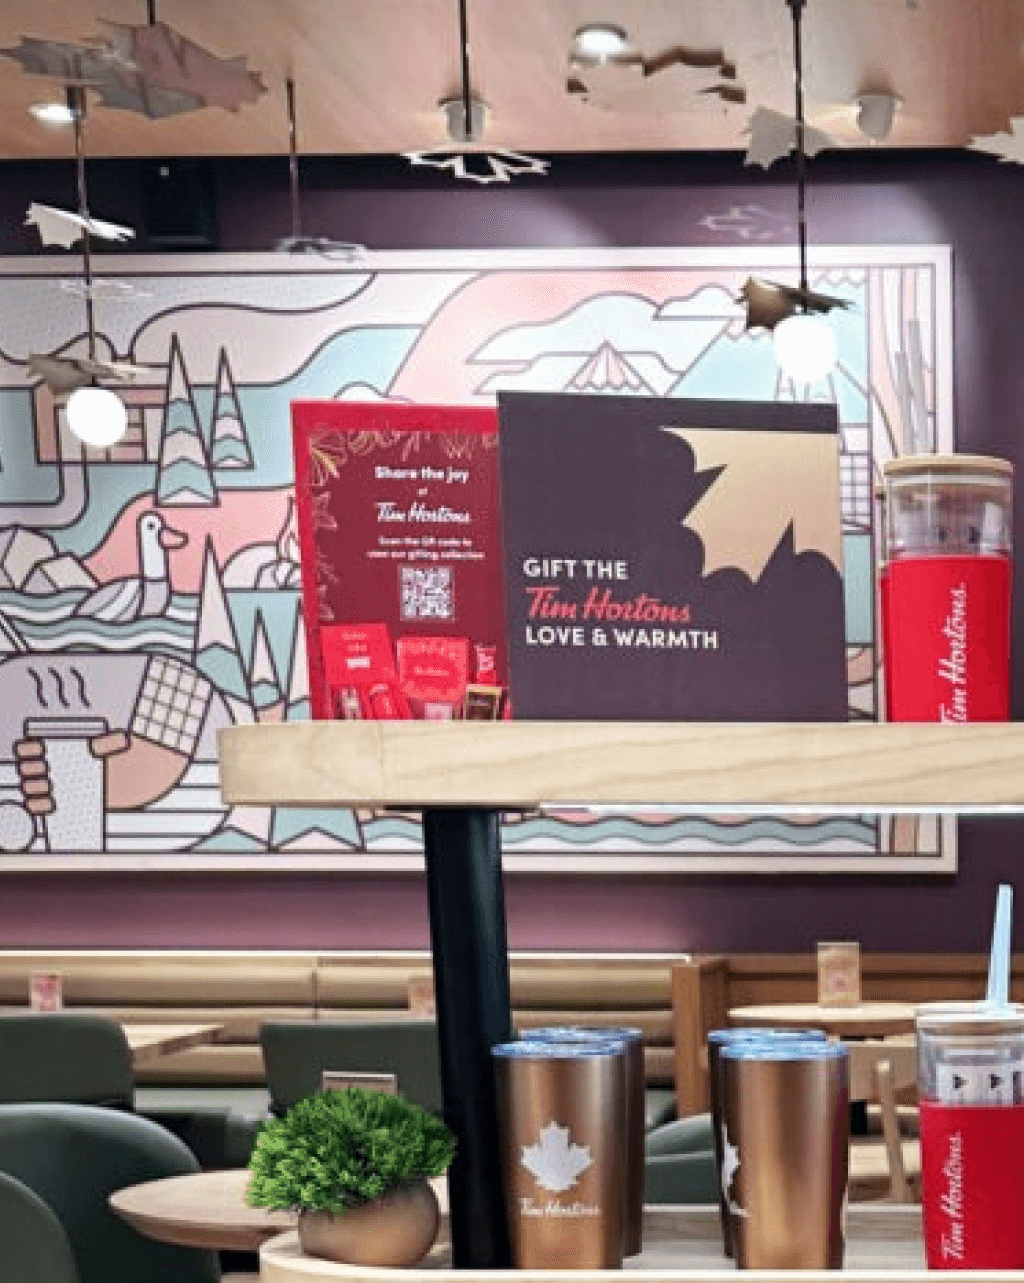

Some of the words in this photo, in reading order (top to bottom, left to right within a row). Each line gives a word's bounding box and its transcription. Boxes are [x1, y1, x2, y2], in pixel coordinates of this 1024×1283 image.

[375, 466, 417, 479] Share
[421, 466, 444, 479] the
[447, 466, 470, 484] joy
[374, 502, 405, 523] Tim
[408, 502, 471, 523] Hortons
[523, 557, 577, 579] GIFT
[581, 559, 629, 580] THE
[525, 587, 577, 619] Tim
[583, 587, 692, 622] Hortons
[525, 626, 585, 647] LOVE
[592, 628, 607, 647] &
[613, 628, 720, 650] WARMTH
[936, 581, 967, 685] Hortons
[938, 688, 967, 723] Tim
[939, 1130, 964, 1219] Hortons
[941, 1222, 965, 1261] Tim
